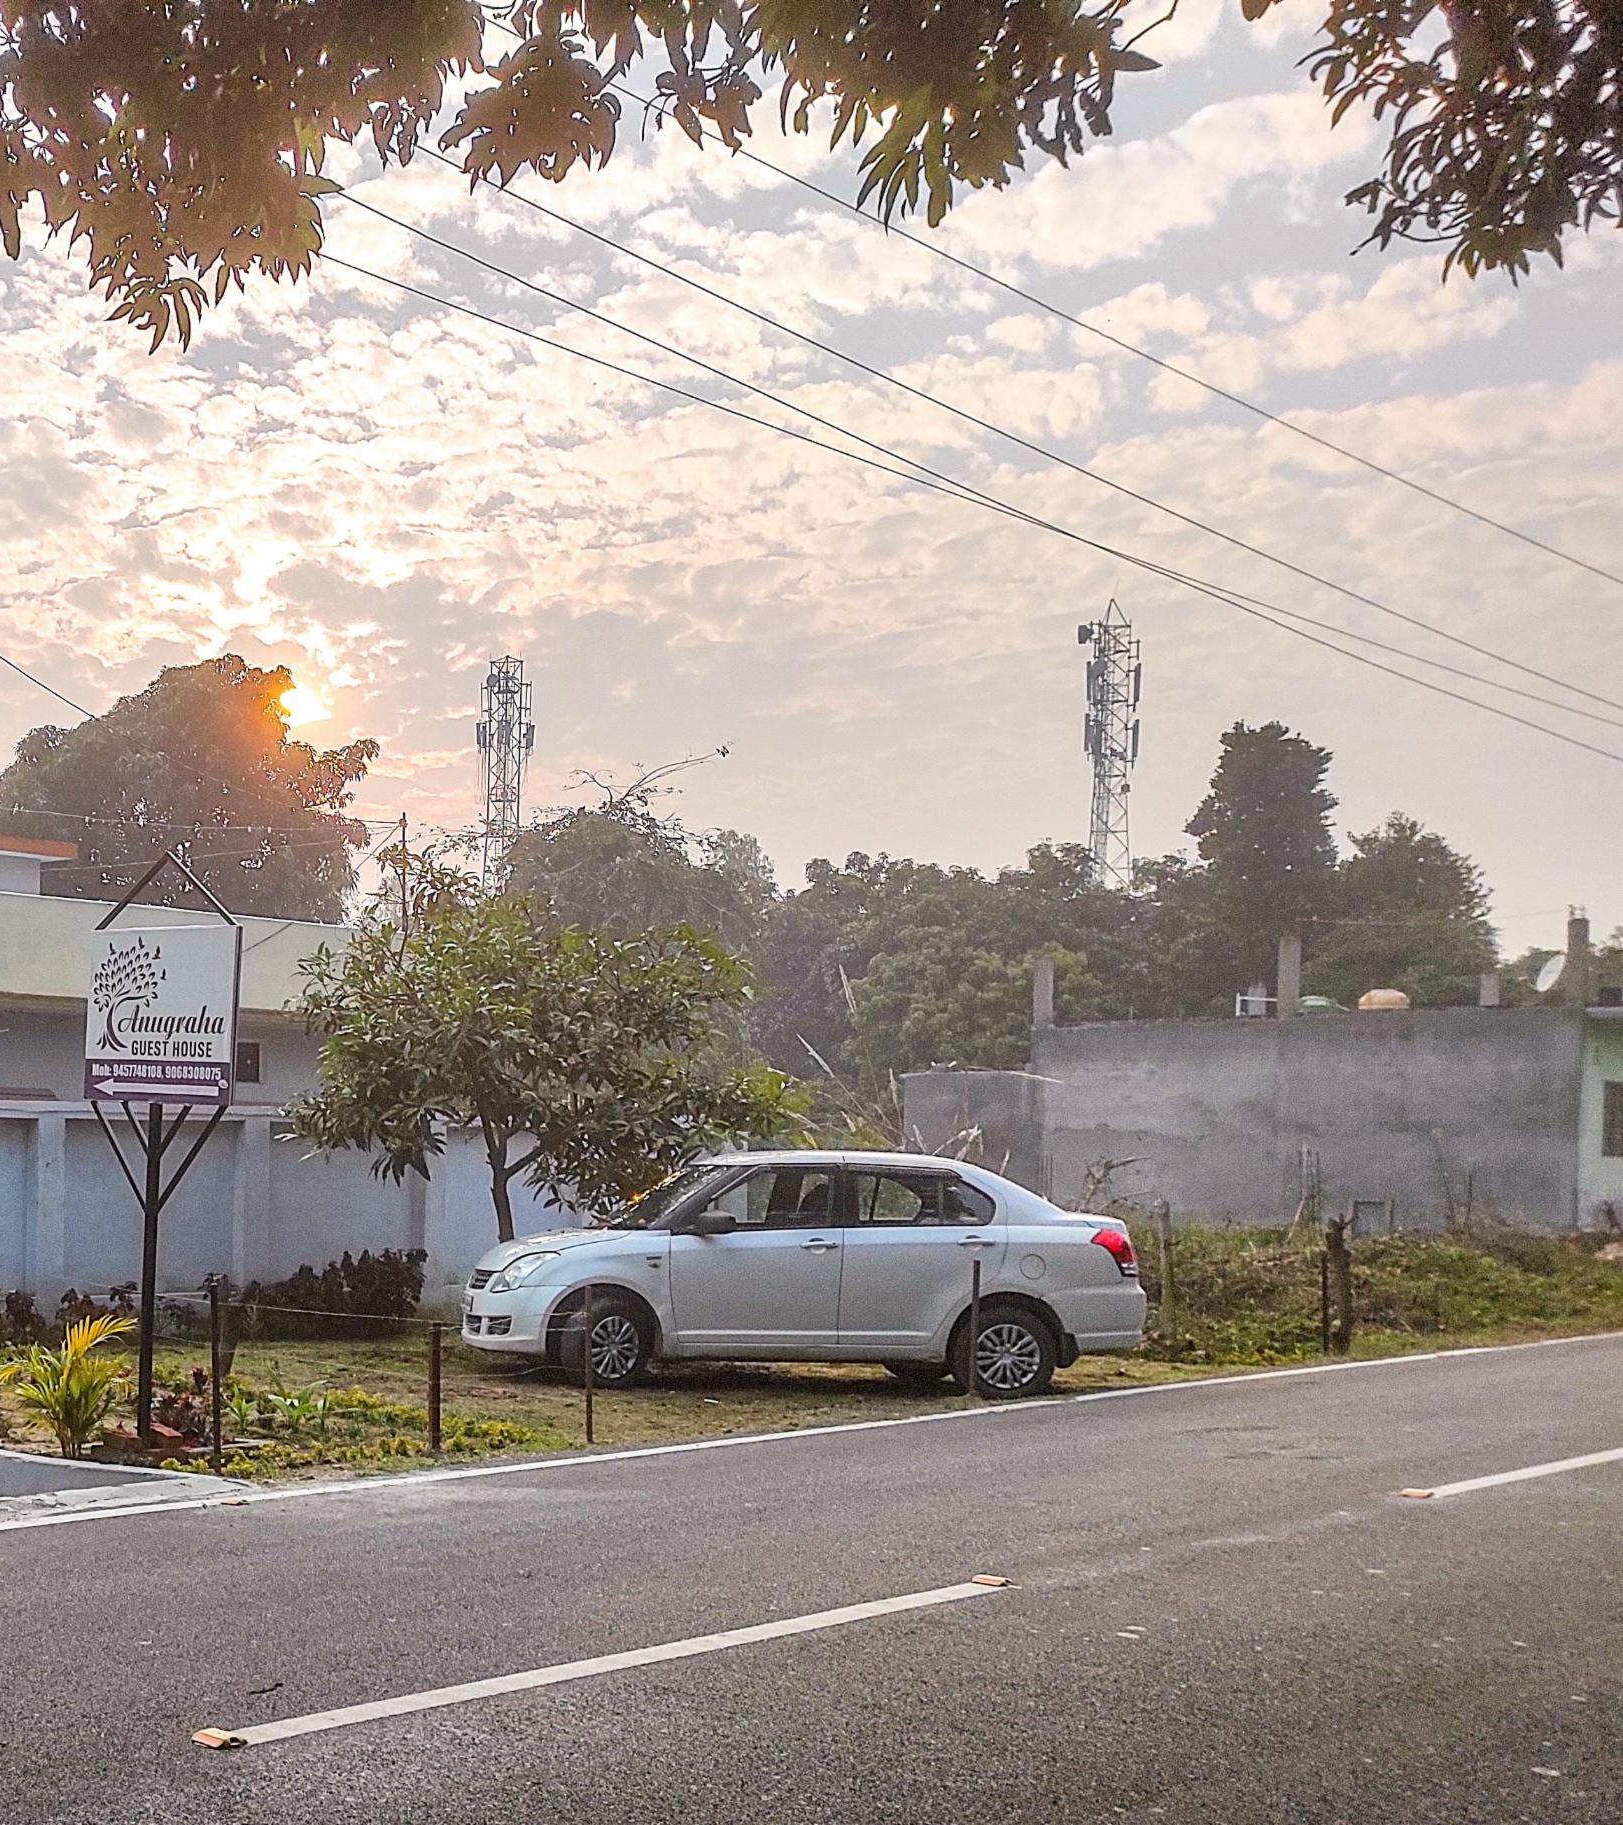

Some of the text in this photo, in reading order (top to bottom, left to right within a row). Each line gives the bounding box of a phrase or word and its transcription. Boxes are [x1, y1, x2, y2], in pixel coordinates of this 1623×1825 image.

[117, 1004, 225, 1040] Anugraha
[131, 1040, 212, 1058] GUEST HOUSE
[91, 1063, 222, 1081] Mob: 9457748108, 9068308075
